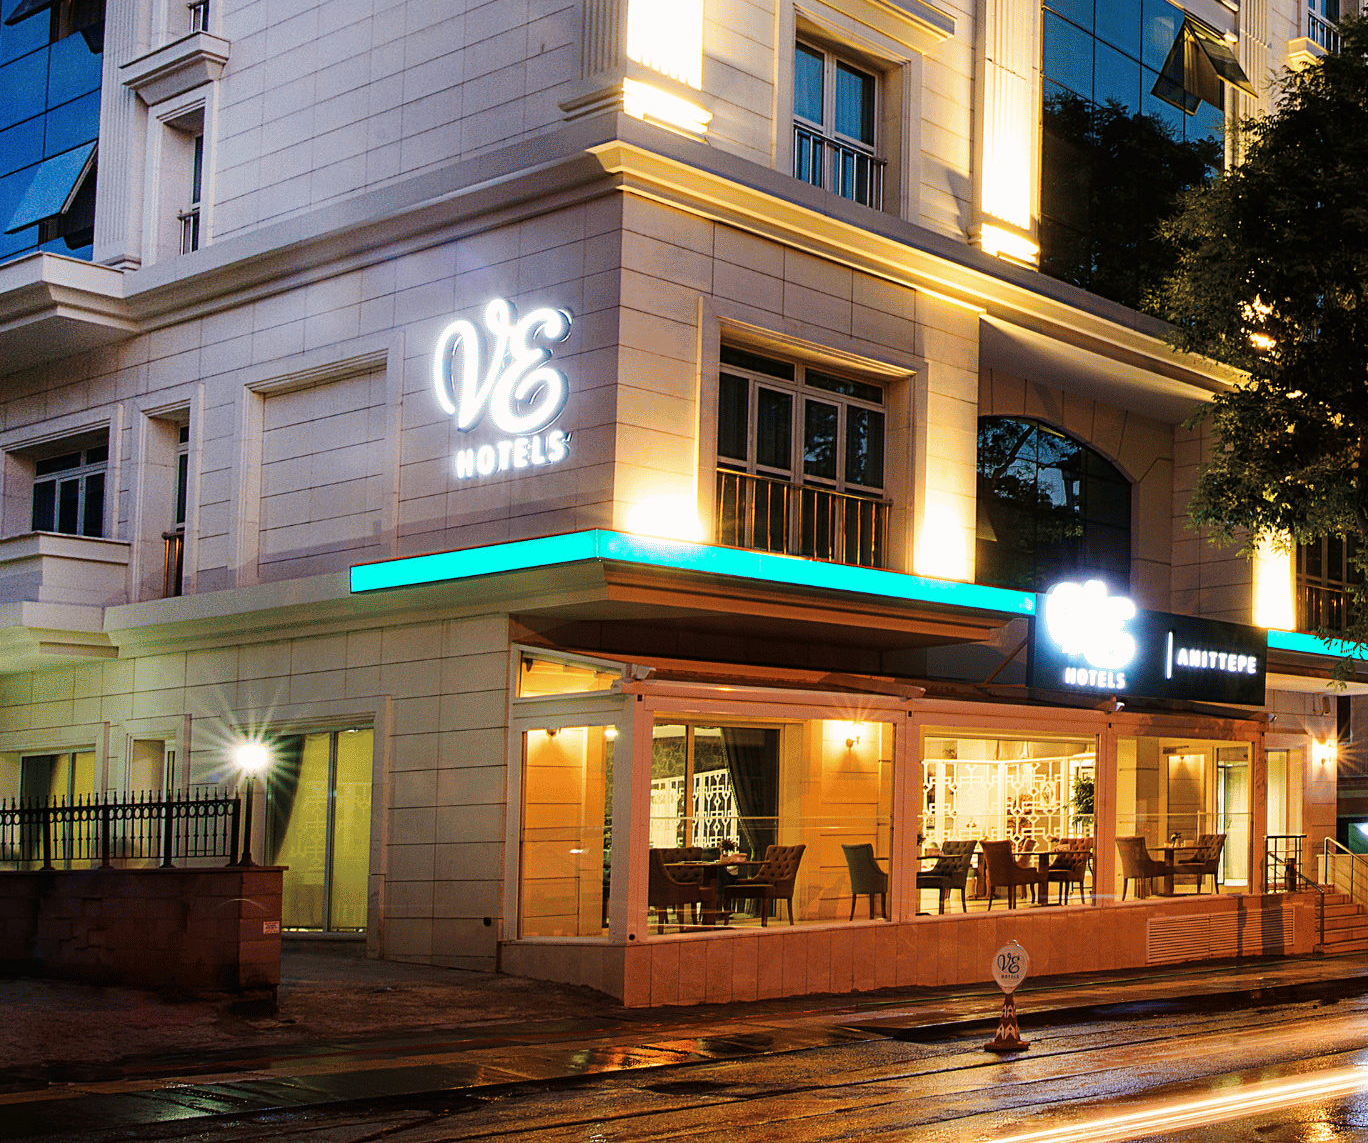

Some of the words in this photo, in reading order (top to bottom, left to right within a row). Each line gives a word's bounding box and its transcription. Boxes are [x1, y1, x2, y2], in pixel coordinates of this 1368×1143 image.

[433, 298, 573, 435] VE
[456, 430, 572, 478] HOTELS
[1176, 647, 1258, 675] ANITTEPE
[1064, 667, 1126, 690] HOTELS
[997, 952, 1020, 974] VE
